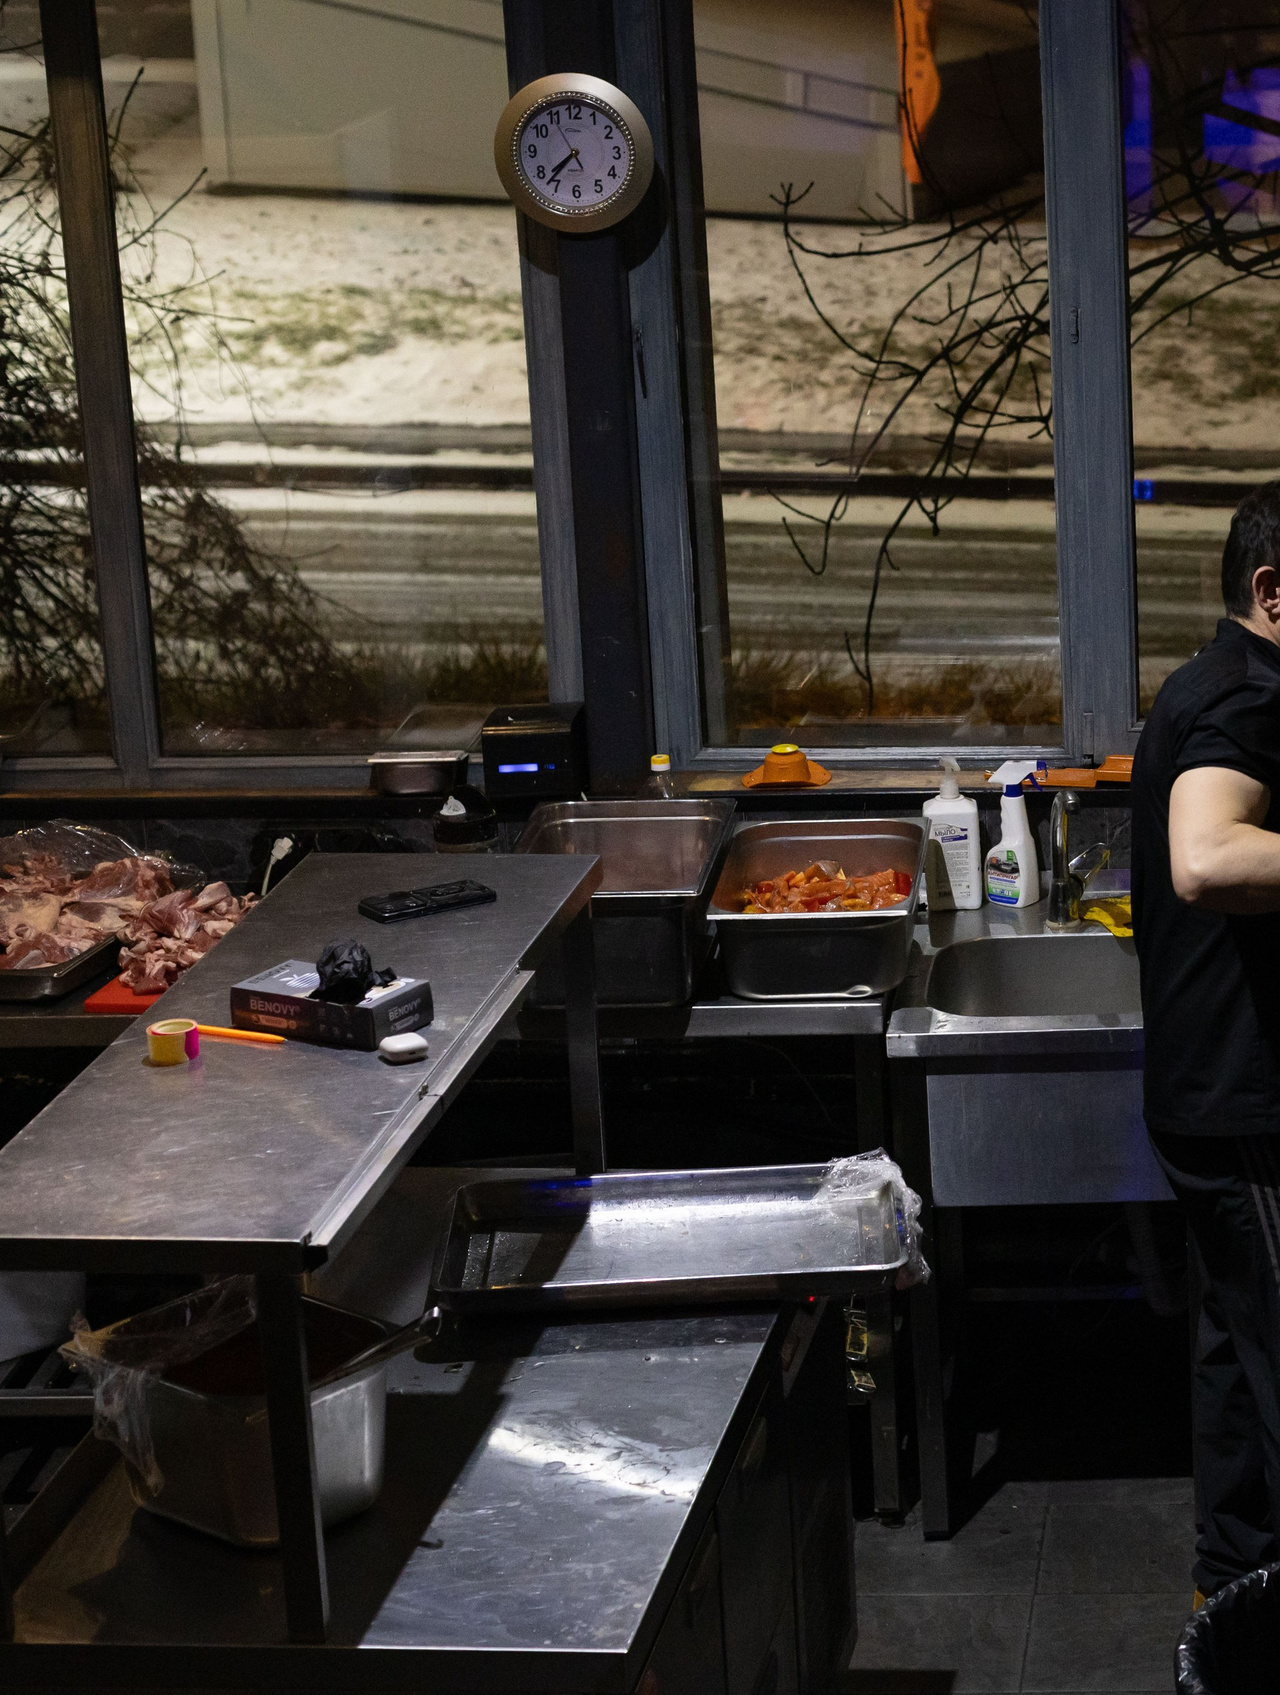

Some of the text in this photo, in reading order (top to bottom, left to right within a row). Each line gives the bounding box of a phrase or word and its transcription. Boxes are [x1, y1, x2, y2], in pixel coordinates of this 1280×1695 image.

[546, 110, 560, 125] 11
[565, 104, 582, 120] 12
[590, 111, 597, 125] 1
[532, 124, 548, 138] 10
[604, 125, 614, 139] 2
[528, 144, 537, 158] 9
[612, 146, 621, 160] 3
[536, 165, 545, 179] 8
[607, 165, 617, 179] 4
[552, 179, 561, 193] 7
[572, 184, 581, 198] 6
[594, 179, 603, 193] 5
[250, 998, 295, 1016] BENOVY
